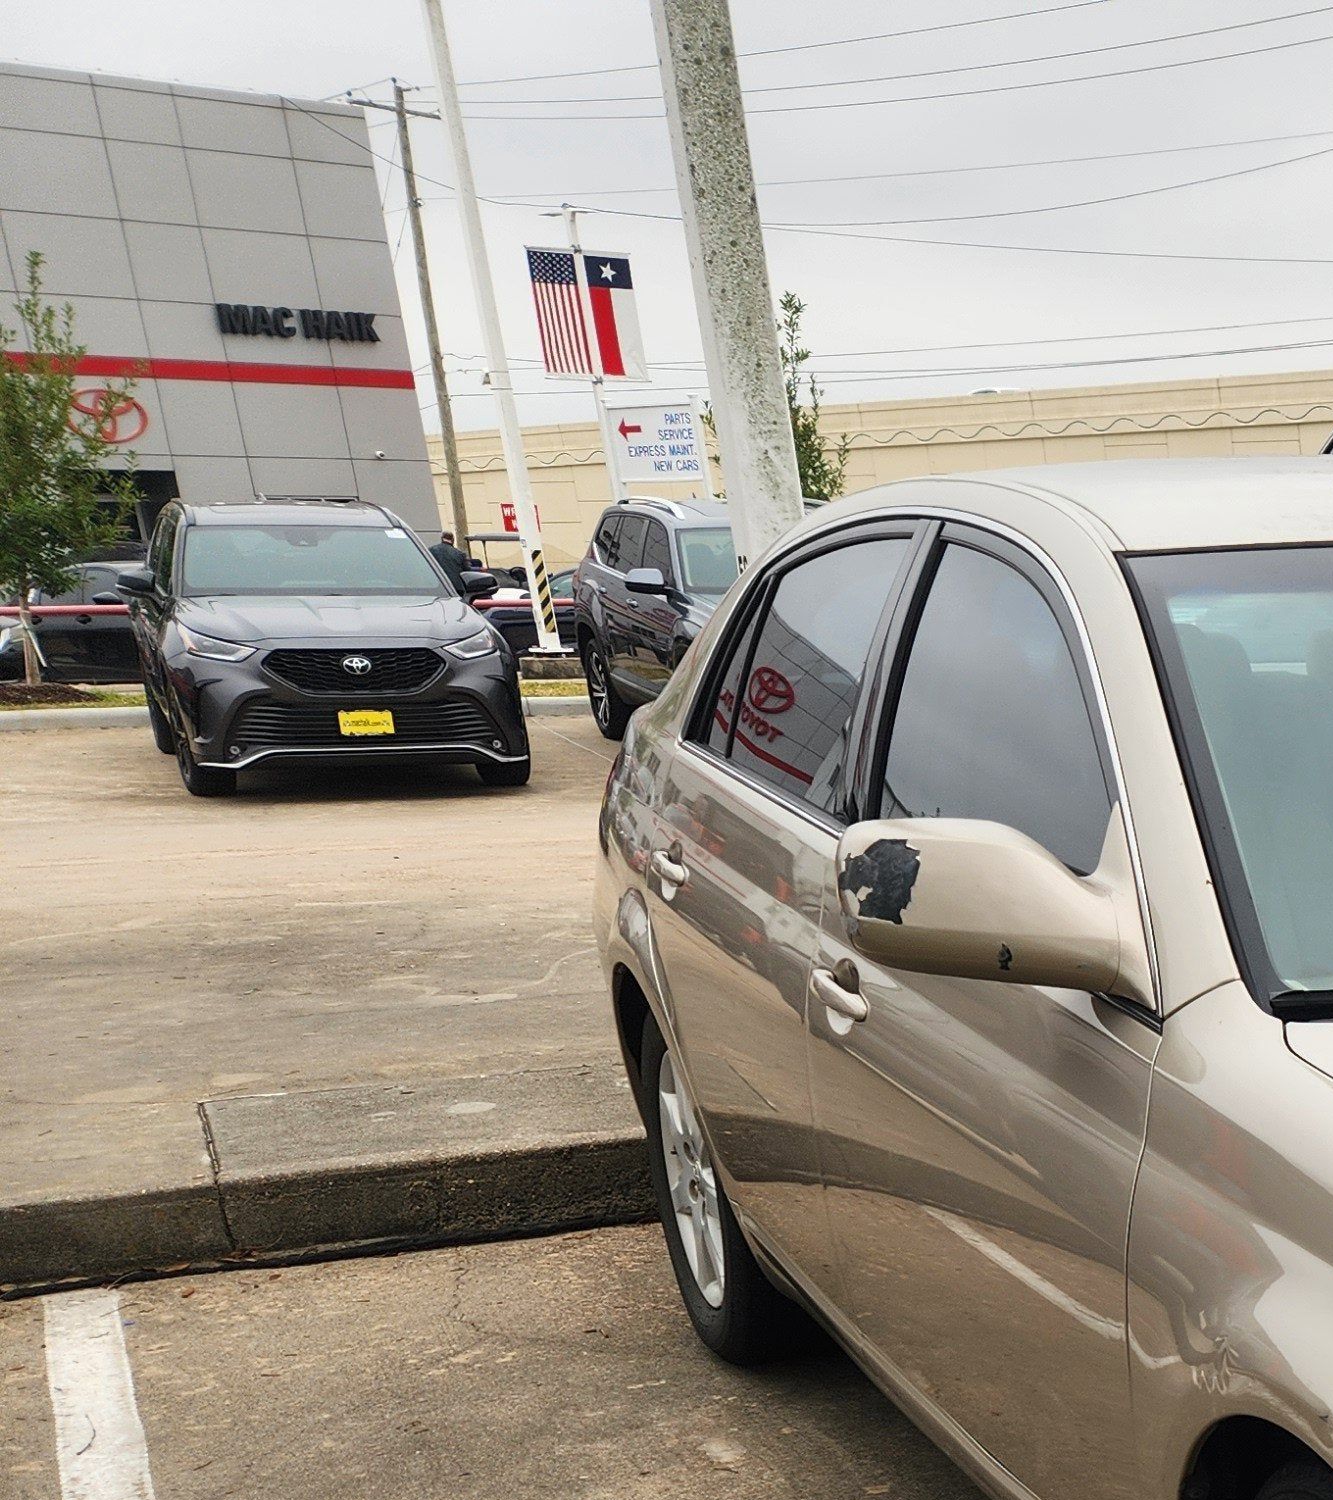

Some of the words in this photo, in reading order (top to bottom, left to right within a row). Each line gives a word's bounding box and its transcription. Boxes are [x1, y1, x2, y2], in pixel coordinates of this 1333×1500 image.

[215, 303, 297, 338] MAC
[300, 308, 381, 342] HAIK
[664, 412, 691, 425] PARTS
[657, 428, 694, 441] SERVICE
[628, 445, 667, 458] EXPRESS
[668, 444, 698, 456] MAINT.
[653, 460, 673, 472] NEW
[676, 459, 699, 472] CARS
